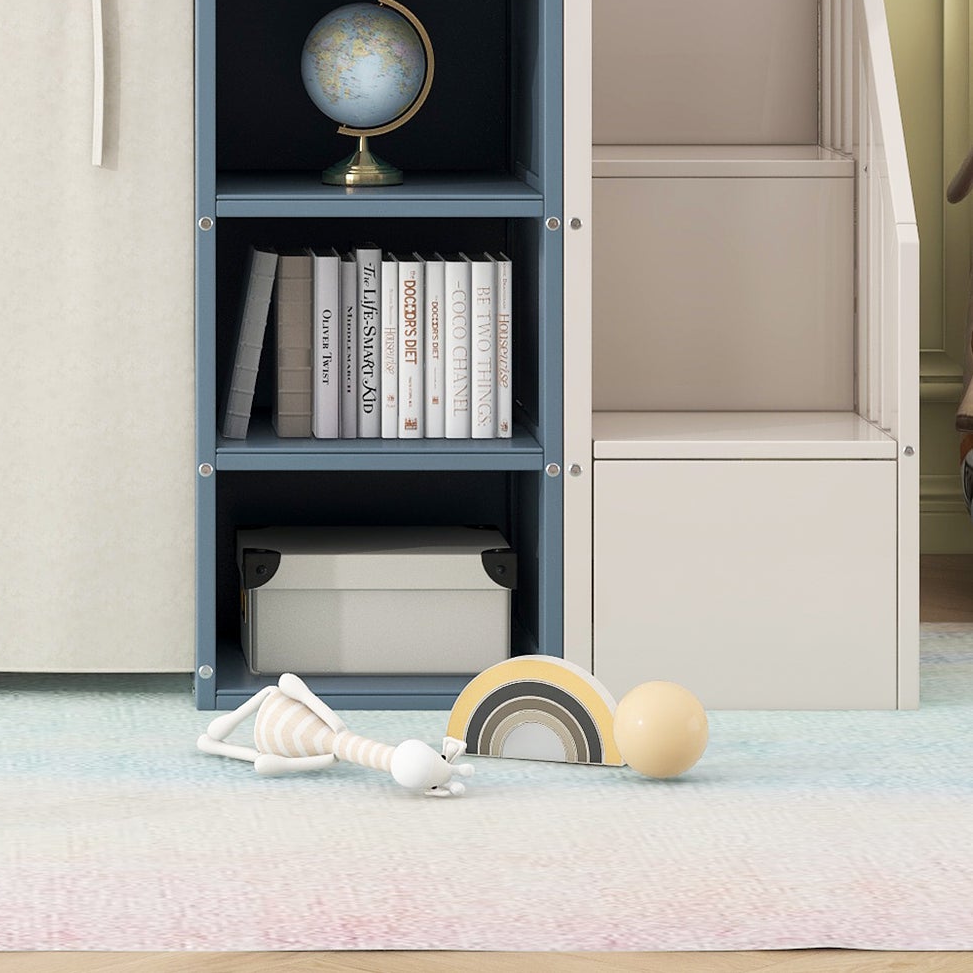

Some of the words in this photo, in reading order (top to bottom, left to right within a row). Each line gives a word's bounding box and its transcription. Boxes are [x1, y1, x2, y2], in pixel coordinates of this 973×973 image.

[476, 286, 491, 307] BE
[476, 311, 491, 352] TWO
[405, 340, 417, 365] DIET
[431, 342, 439, 359] DIET
[453, 346, 468, 417] CHANEL
[476, 357, 492, 427] THINGS:
